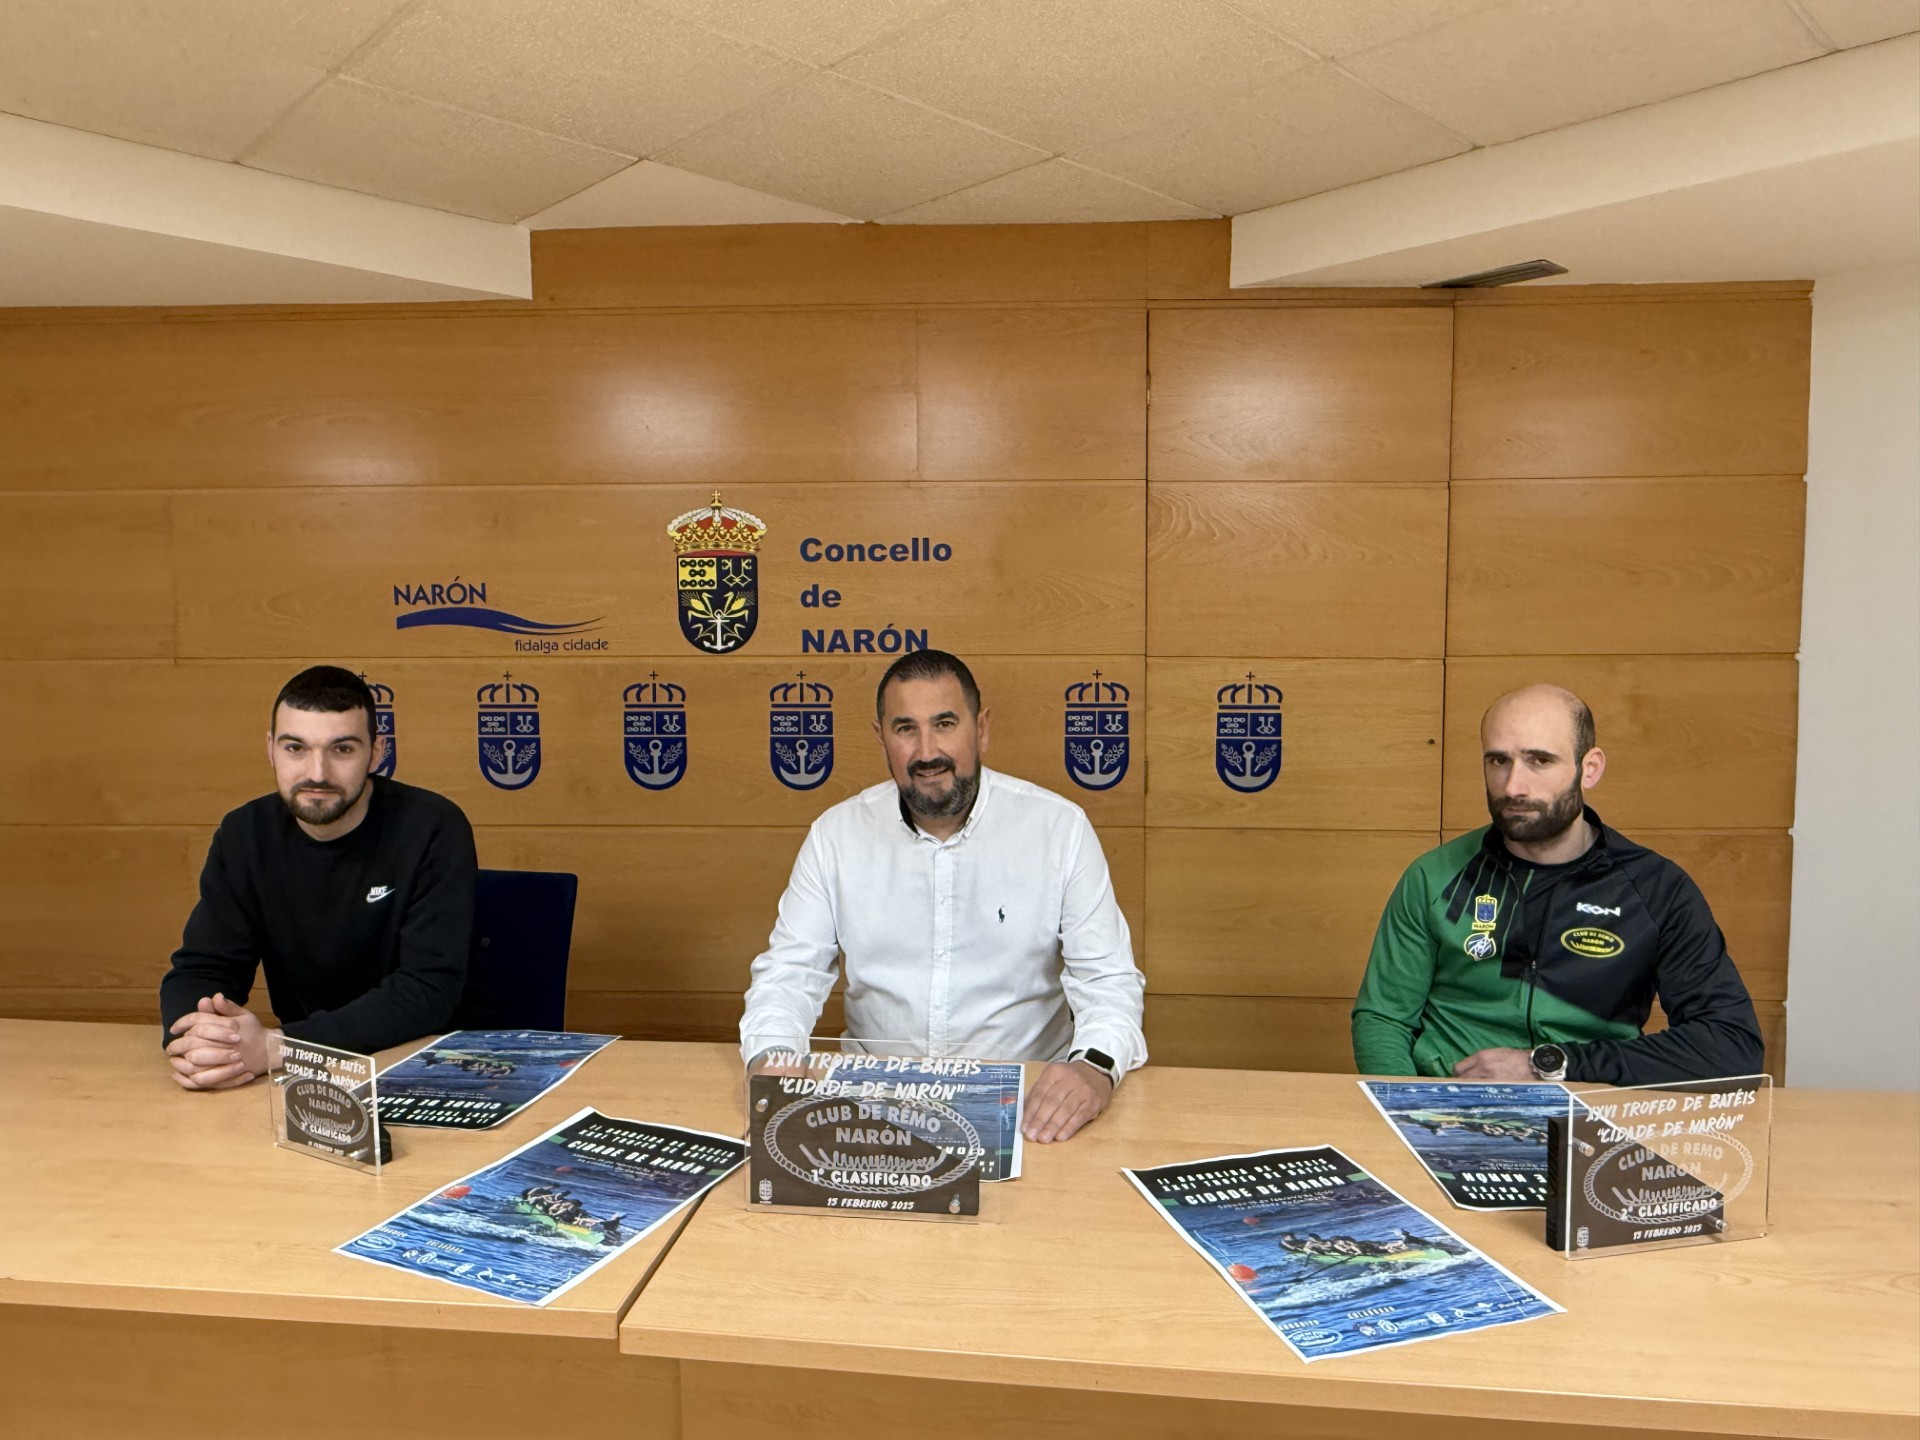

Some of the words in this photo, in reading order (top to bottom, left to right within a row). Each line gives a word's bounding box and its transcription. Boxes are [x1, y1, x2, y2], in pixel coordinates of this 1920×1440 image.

[800, 538, 952, 562] Concello
[393, 576, 486, 605] NARÓN
[800, 584, 842, 608] de
[514, 639, 559, 653] fidalga
[563, 638, 609, 651] cidade
[802, 623, 928, 653] NARÓN
[765, 1051, 804, 1068] XXVI
[809, 1053, 878, 1070] TROFEO
[884, 1056, 912, 1072] DE
[859, 1081, 888, 1098] DE
[1622, 1098, 1677, 1118] TROFEO
[1681, 1096, 1704, 1112] DE
[1708, 1088, 1756, 1109] BATÉIS
[806, 1105, 852, 1128] CLUB
[859, 1103, 882, 1120] DE
[888, 1106, 940, 1133] REMO
[1661, 1121, 1684, 1137] DE
[836, 1125, 911, 1146] NARÓN
[567, 1140, 625, 1157] CIDADE
[625, 1151, 649, 1163] DE
[1618, 1147, 1655, 1171] CLUB
[1660, 1142, 1678, 1155] DE
[1683, 1142, 1724, 1160] REMO
[830, 1170, 932, 1186] CLASIFICADO
[1184, 1187, 1253, 1205] CIDADE
[1256, 1184, 1282, 1195] DE
[1284, 1175, 1346, 1191] NARÓN
[827, 1197, 838, 1206] 15
[841, 1198, 888, 1209] FEBREIRO
[1638, 1198, 1717, 1217] CLASIFICADO
[1644, 1226, 1682, 1238] FEBREIRO
